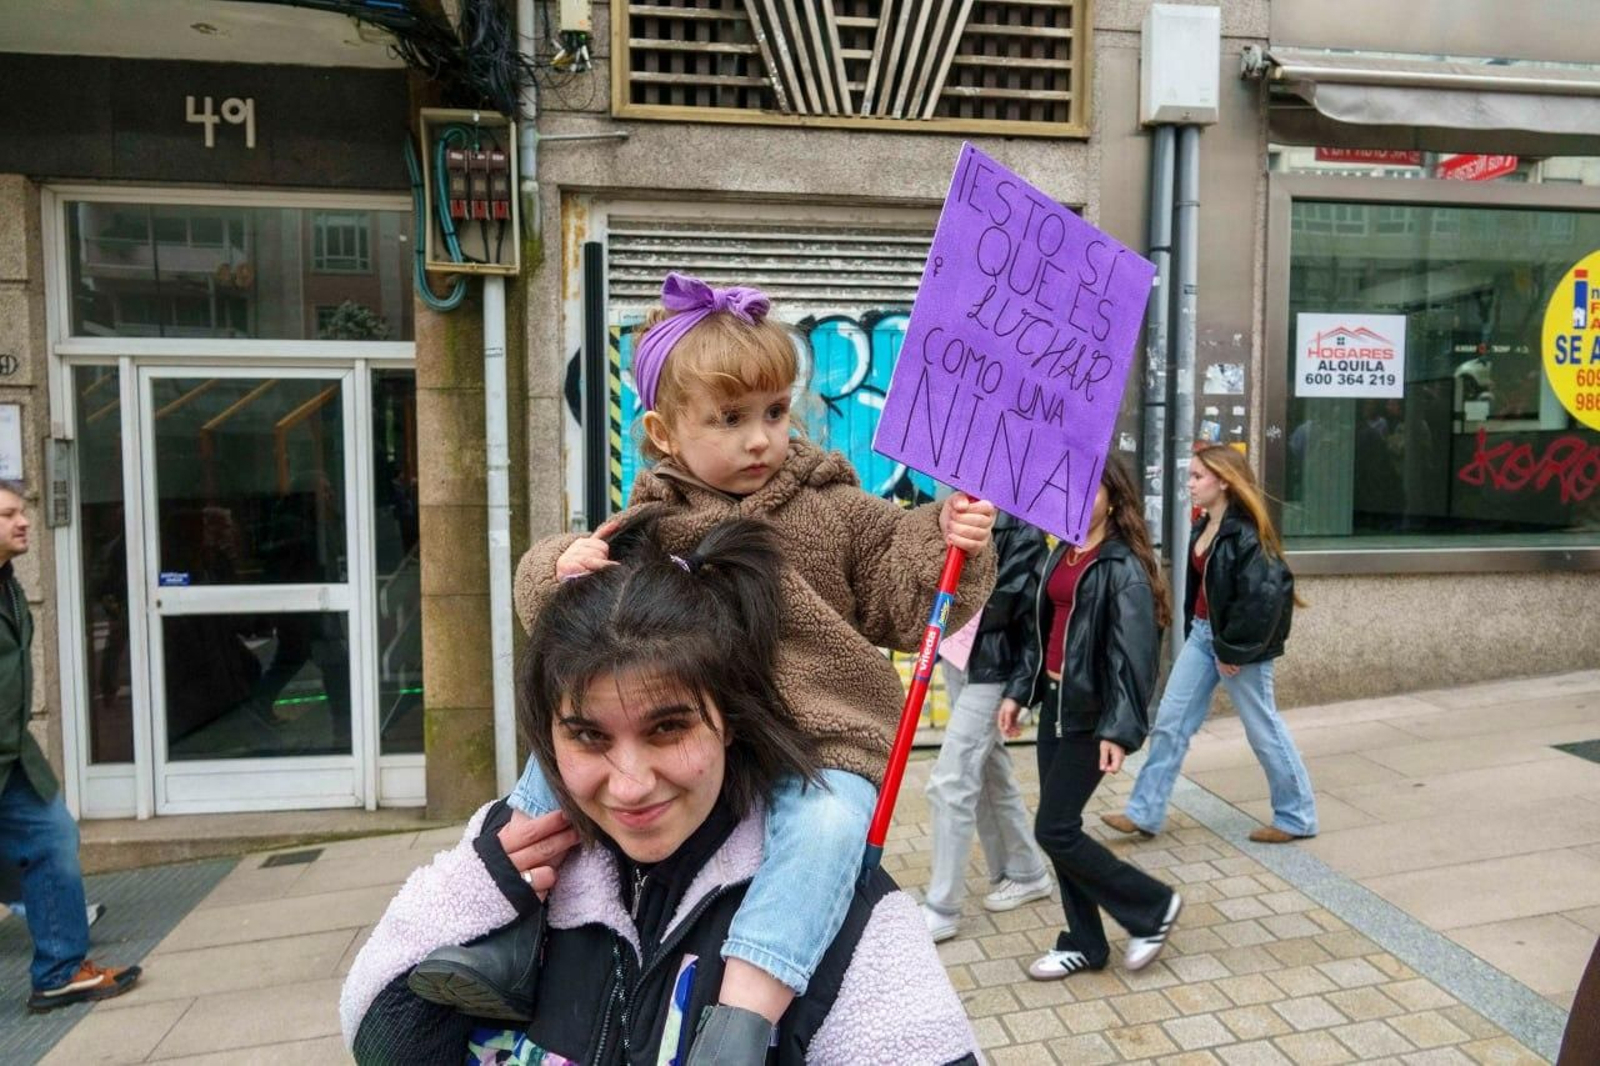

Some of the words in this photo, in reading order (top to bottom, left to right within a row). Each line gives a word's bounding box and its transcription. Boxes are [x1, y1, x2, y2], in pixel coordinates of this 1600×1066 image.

[186, 95, 256, 149] 49
[976, 225, 1066, 312] QUE
[1068, 283, 1115, 342] ES
[966, 284, 1113, 402] LUCHAR
[1307, 338, 1395, 360] HOGARES
[1555, 335, 1582, 365] SE
[923, 326, 1004, 394] COMO
[1017, 377, 1065, 428] UNA
[1305, 373, 1332, 386] 600
[1337, 374, 1364, 386] 364
[1369, 374, 1396, 387] 219
[1318, 360, 1385, 372] ALQUILA
[920, 631, 936, 671] vileda
